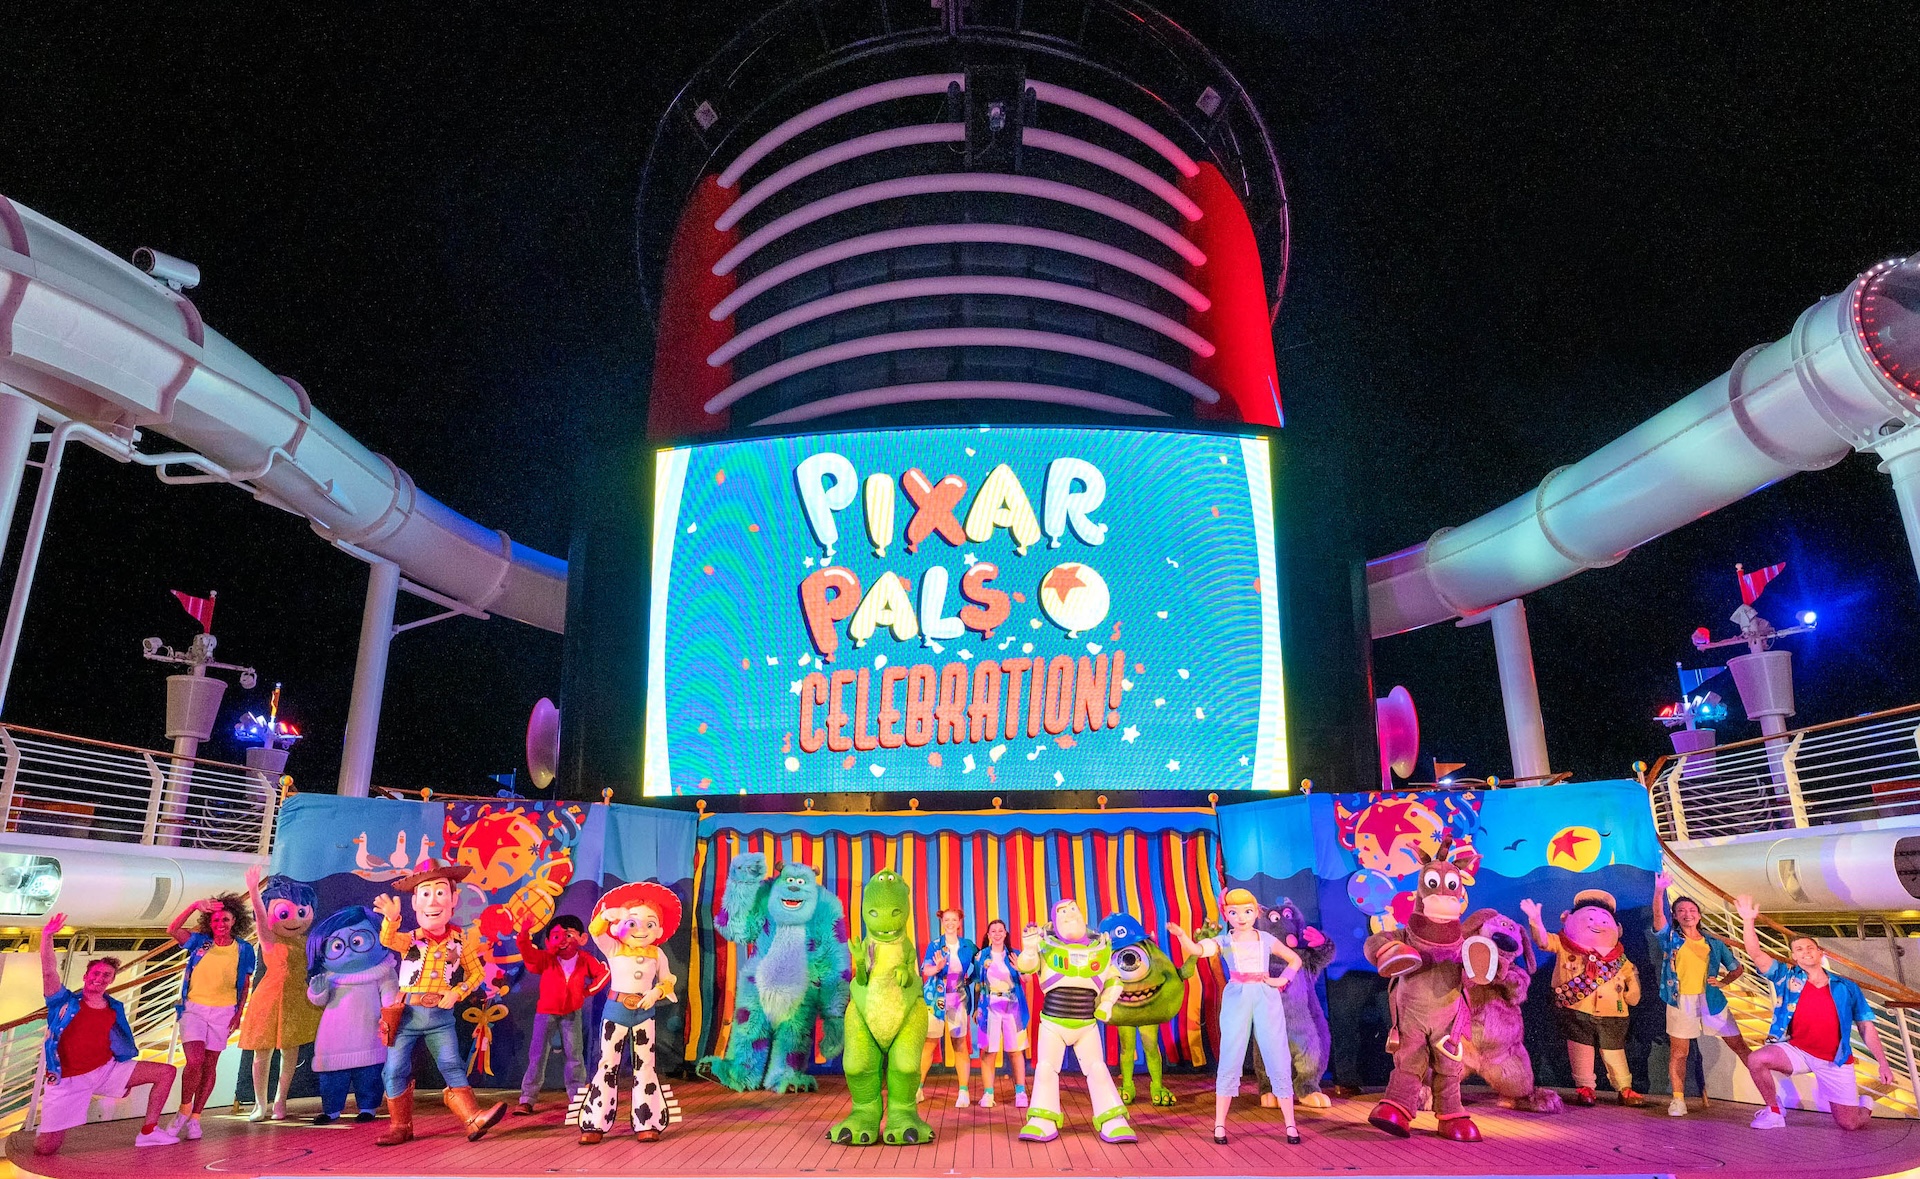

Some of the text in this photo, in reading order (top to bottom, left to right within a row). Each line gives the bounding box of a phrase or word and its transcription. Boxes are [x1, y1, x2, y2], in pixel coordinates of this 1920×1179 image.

[795, 452, 1108, 556] PIXAR
[799, 562, 1011, 663] PALS
[799, 650, 1126, 753] CELEBRATION!
